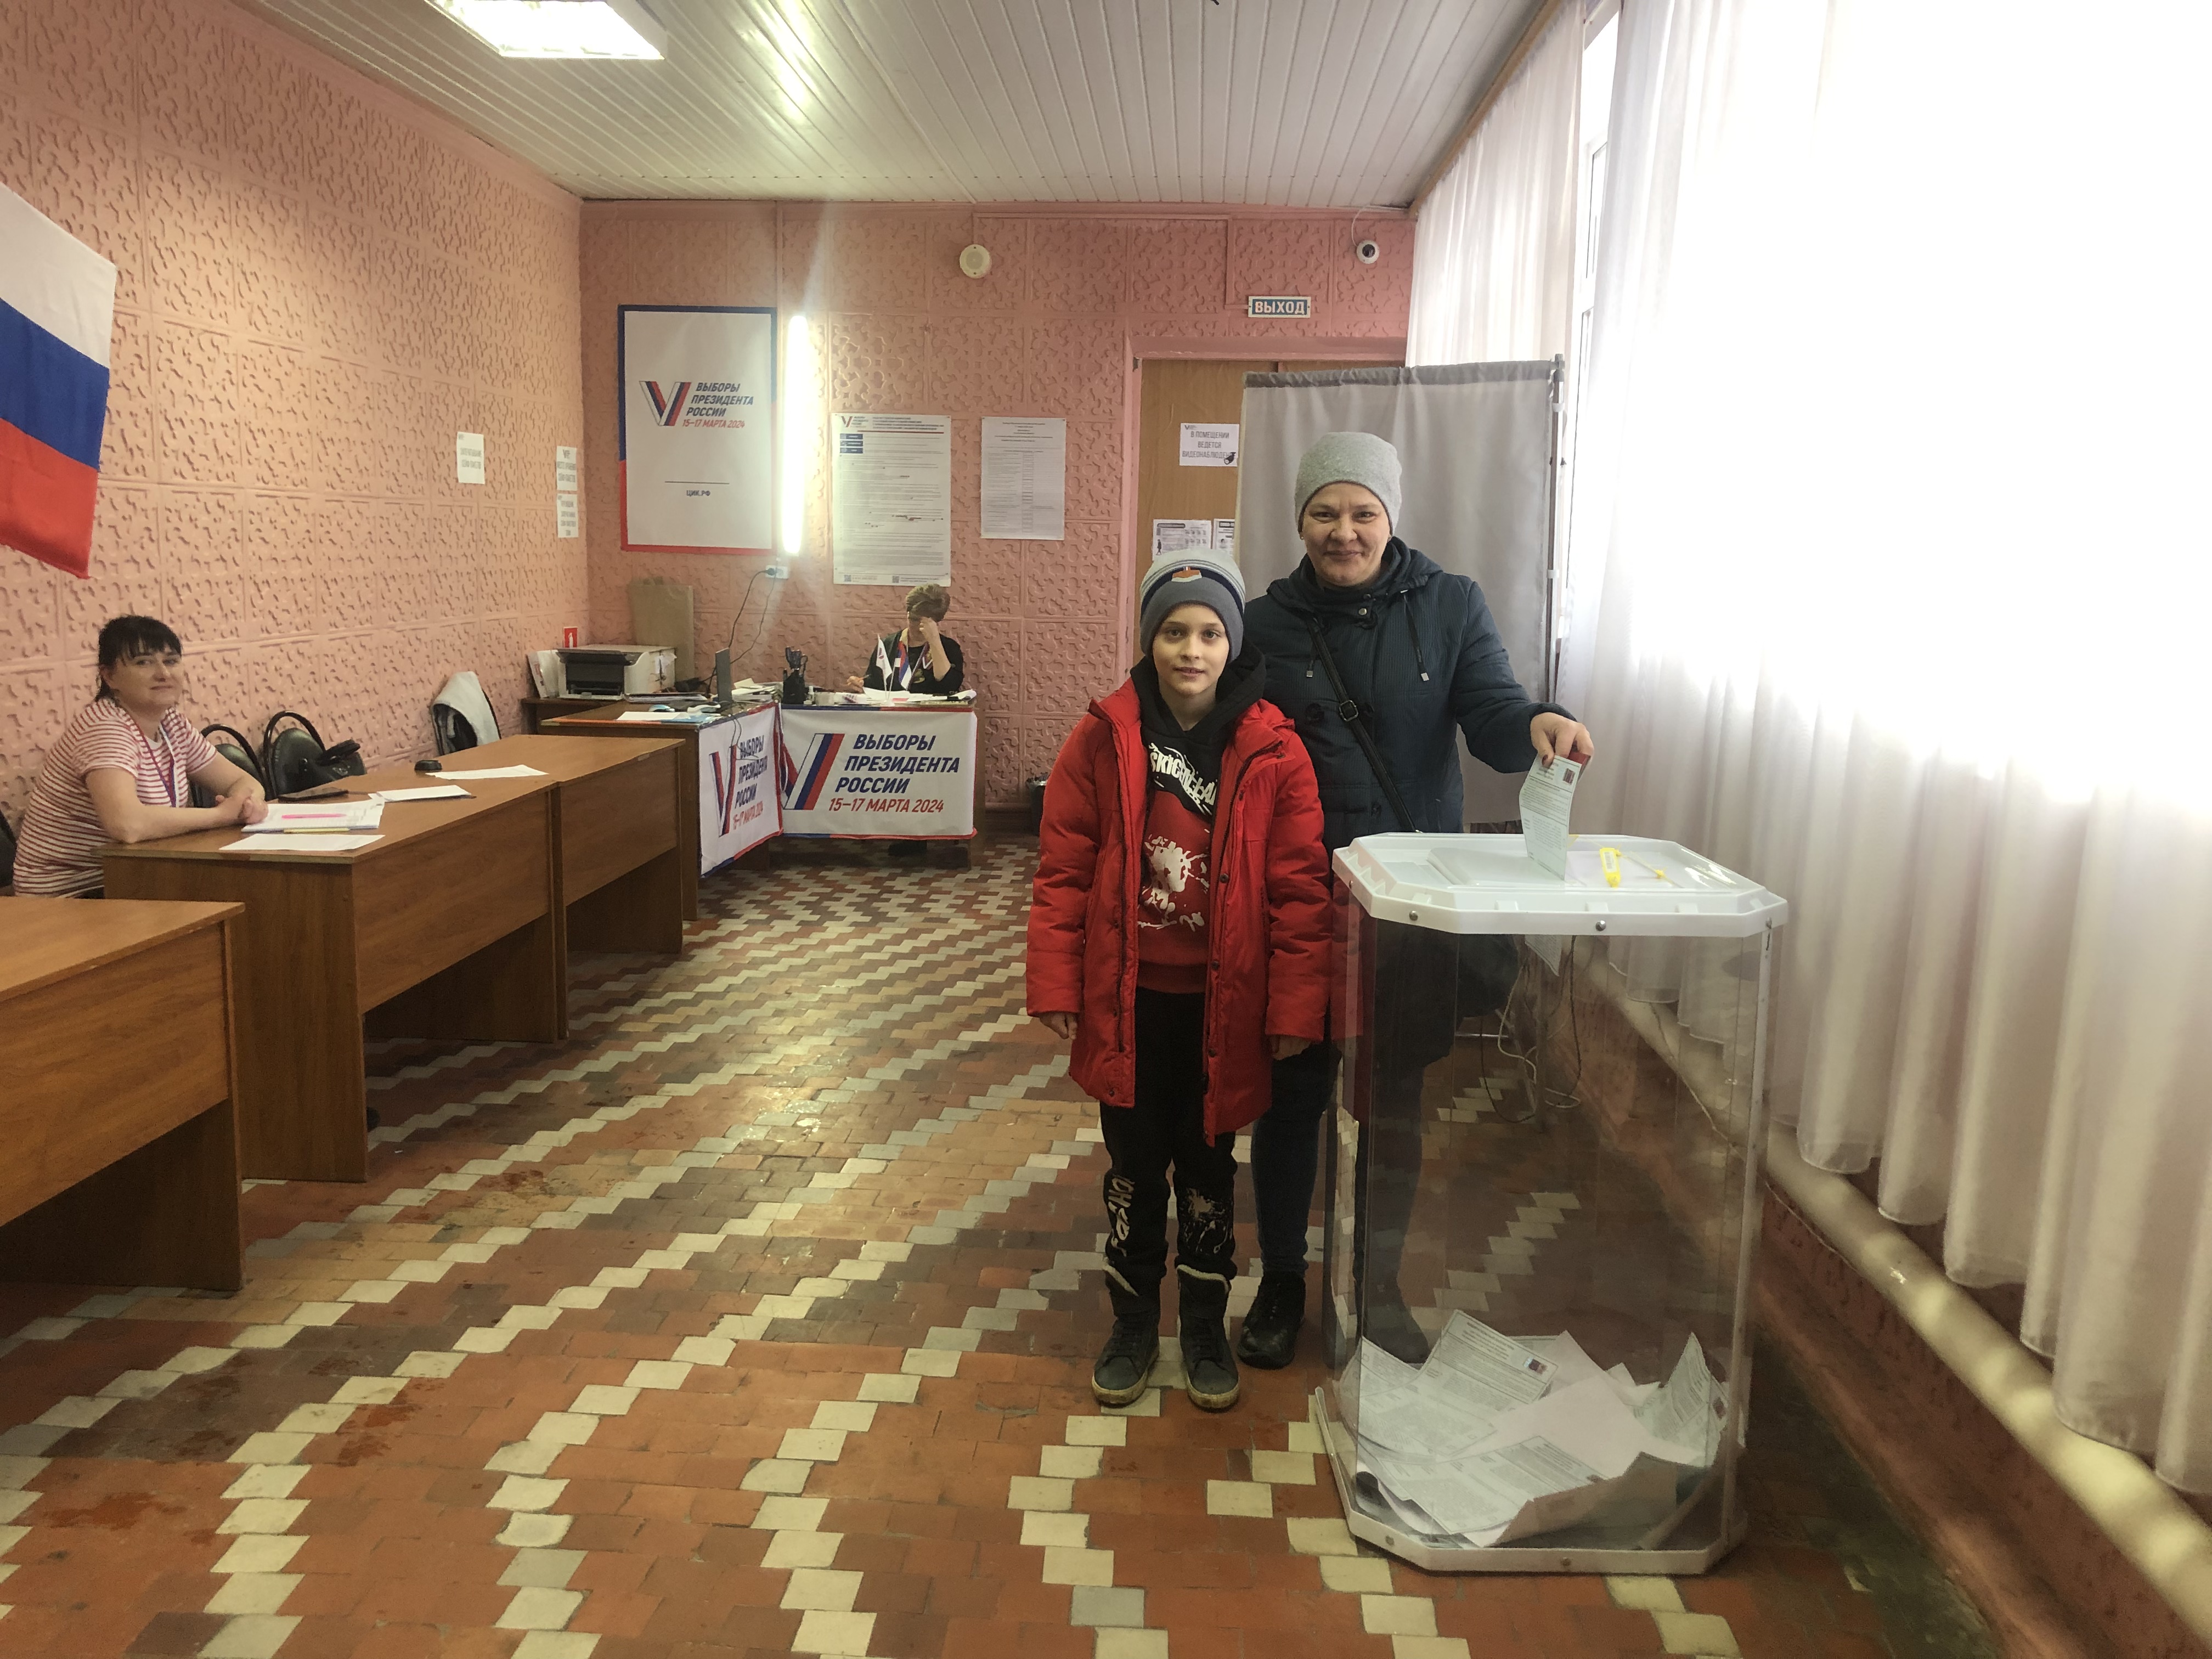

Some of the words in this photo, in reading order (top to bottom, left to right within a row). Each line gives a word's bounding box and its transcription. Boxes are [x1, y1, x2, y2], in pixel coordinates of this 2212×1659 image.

[1255, 301, 1305, 314] ВЫХОД
[695, 382, 741, 392] ВЫБОРЫ
[691, 394, 754, 406] ПРЕЗИДЕНТА
[686, 407, 727, 417] РОССИИ
[702, 419, 727, 428] МАРТА
[727, 420, 746, 428] 2024
[1182, 450, 1233, 459] ВИДЕОНАБЛЮДЕН
[853, 733, 936, 751] ВЫБОРЫ
[844, 755, 960, 775] ПРЕЗИДЕНТА
[834, 777, 911, 794] РОССИИ
[865, 799, 911, 812] МАРТА
[911, 799, 944, 813] 2024
